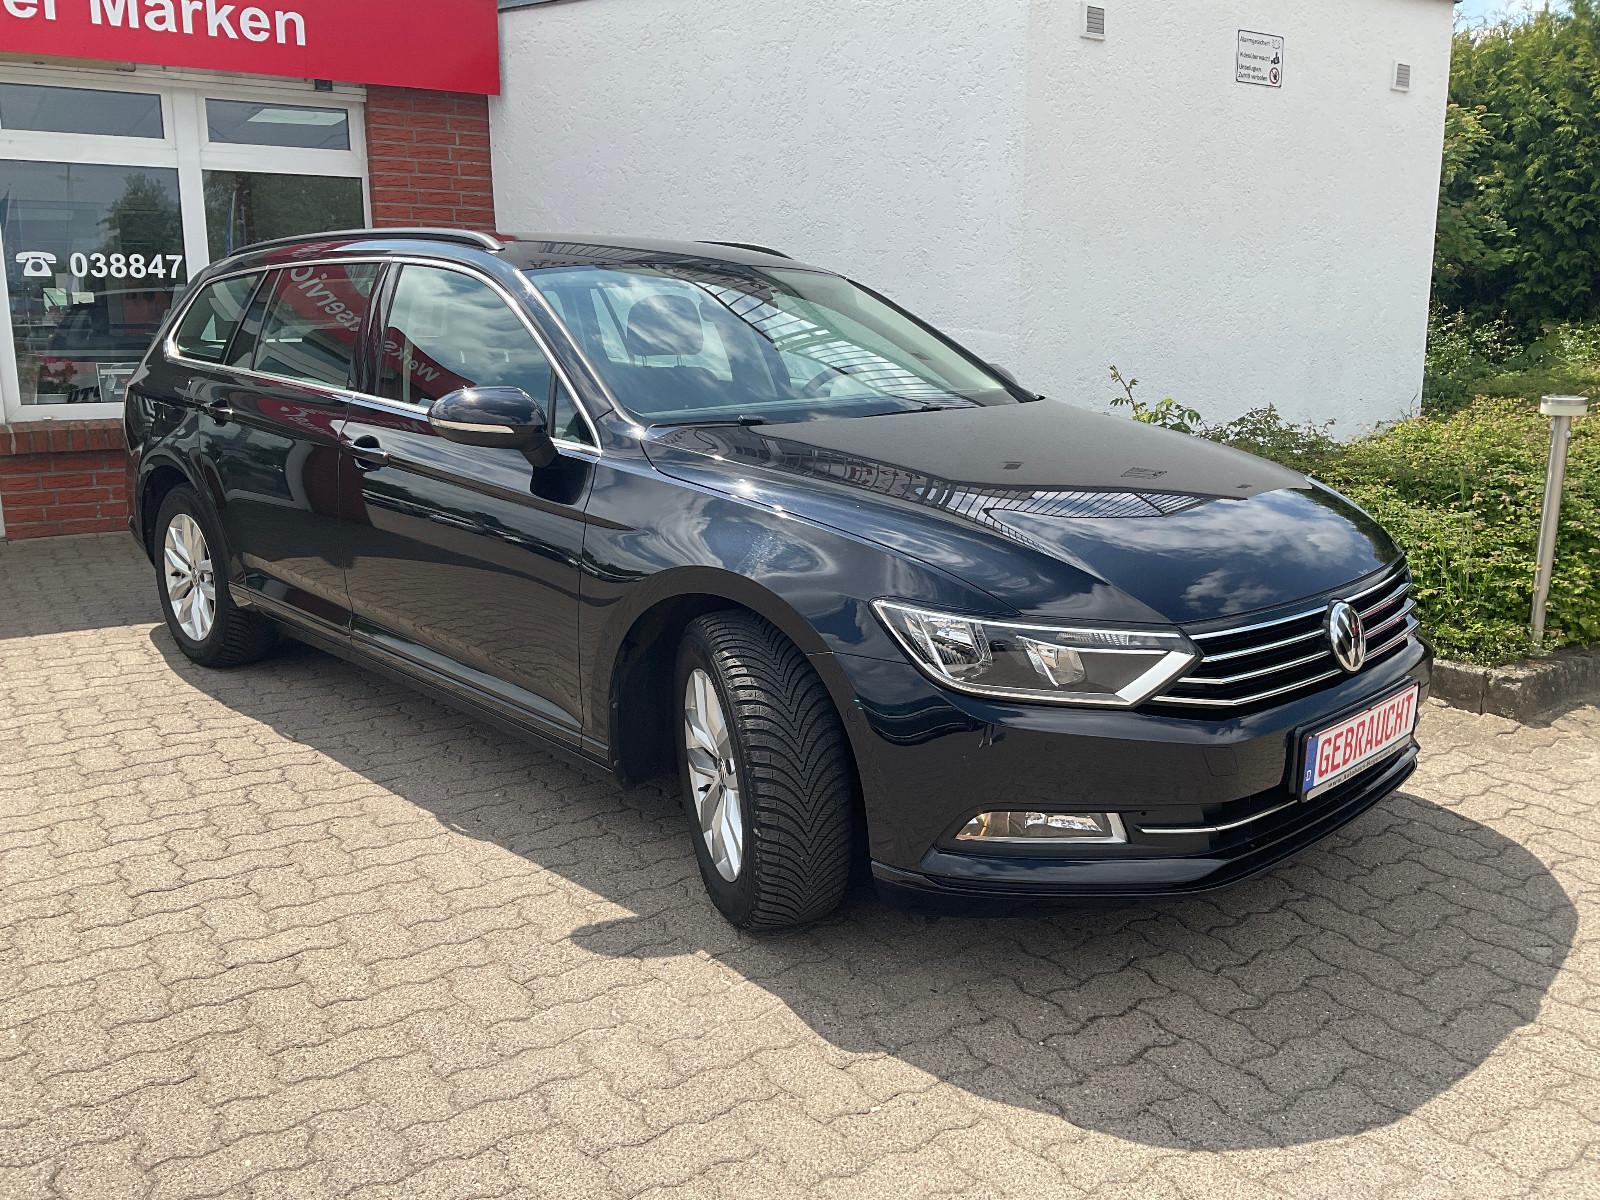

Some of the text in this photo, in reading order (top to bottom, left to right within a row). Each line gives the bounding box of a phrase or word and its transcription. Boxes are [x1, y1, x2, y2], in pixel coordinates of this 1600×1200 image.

[90, 0, 307, 46] Marken
[69, 252, 183, 279] 038847
[1317, 692, 1414, 779] GEBRAUCHT
[1305, 769, 1312, 782] D
